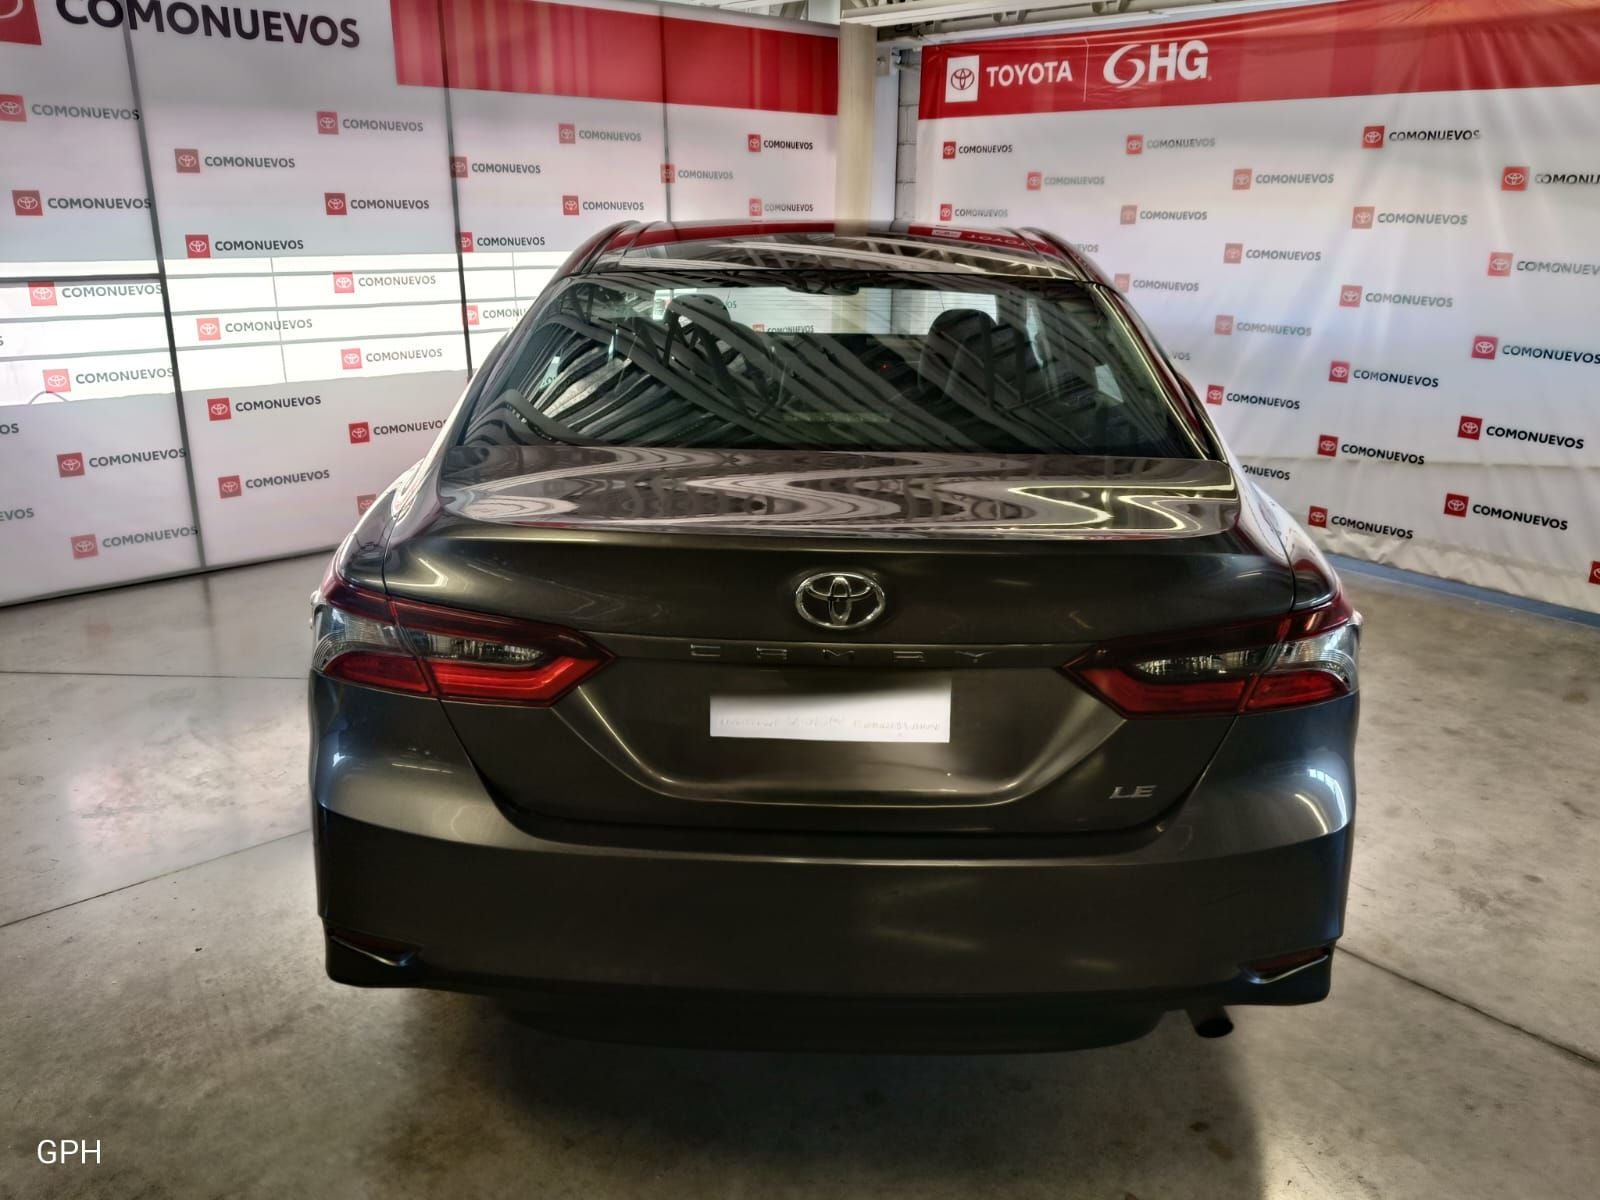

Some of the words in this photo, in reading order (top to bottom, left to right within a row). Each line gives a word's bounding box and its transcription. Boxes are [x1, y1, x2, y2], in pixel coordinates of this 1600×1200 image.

[57, 0, 360, 49] COMONUEVOS
[985, 60, 1073, 88] TOYOTA
[31, 104, 140, 120] COMONUEVOS
[342, 118, 424, 132] COMONUEVOS
[578, 130, 641, 142] COMONUEVOS
[1389, 129, 1480, 142] COMONUEVOS
[763, 140, 813, 150] COMONUEVOS
[958, 144, 1013, 154] COMONUEVOS
[1146, 137, 1216, 150] COMONUEVOS
[204, 155, 296, 169] COMONUEVOS
[471, 163, 541, 174] COMONUEVOS
[678, 169, 734, 180] COMONUEVOS
[1044, 176, 1105, 186] COMONUEVOS
[1255, 173, 1334, 185] COMONUEVOS
[47, 197, 152, 210] COMONUEVOS
[350, 199, 430, 210] COMONUEVOS
[582, 200, 644, 211] COMONUEVOS
[764, 204, 814, 213] COMONUEVOS
[954, 208, 1008, 217] COMONUEVOS
[1139, 210, 1208, 221] COMONUEVOS
[1377, 212, 1468, 226] COMONUEVOS
[214, 239, 304, 251] COMONUEVOS
[476, 236, 545, 247] COMONUEVOS
[1245, 249, 1322, 262] COMONUEVOS
[358, 275, 436, 287] COMONUEVOS
[1132, 279, 1200, 292] COMONUEVOS
[62, 284, 162, 298] COMONUEVOS
[1365, 292, 1454, 308] COMONUEVOS
[225, 318, 313, 333] COMONUEVOS
[1236, 321, 1312, 337] COMONUEVOS
[365, 347, 442, 362] COMONUEVOS
[1502, 344, 1600, 365] COMONUEVOS
[75, 367, 174, 384] COMONUEVOS
[1352, 368, 1439, 388] COMONUEVOS
[235, 395, 321, 412] COMONUEVOS
[1226, 392, 1301, 410] COMONUEVOS
[1486, 425, 1584, 449] COMONUEVOS
[89, 448, 187, 468] COMONUEVOS
[1341, 443, 1425, 465] COMONUEVOS
[245, 469, 330, 489] COMONUEVOS
[1472, 503, 1569, 531] COMONUEVOS
[1331, 514, 1414, 540] COMONUEVOS
[102, 525, 198, 548] COMONUEVOS
[1109, 784, 1157, 800] LE
